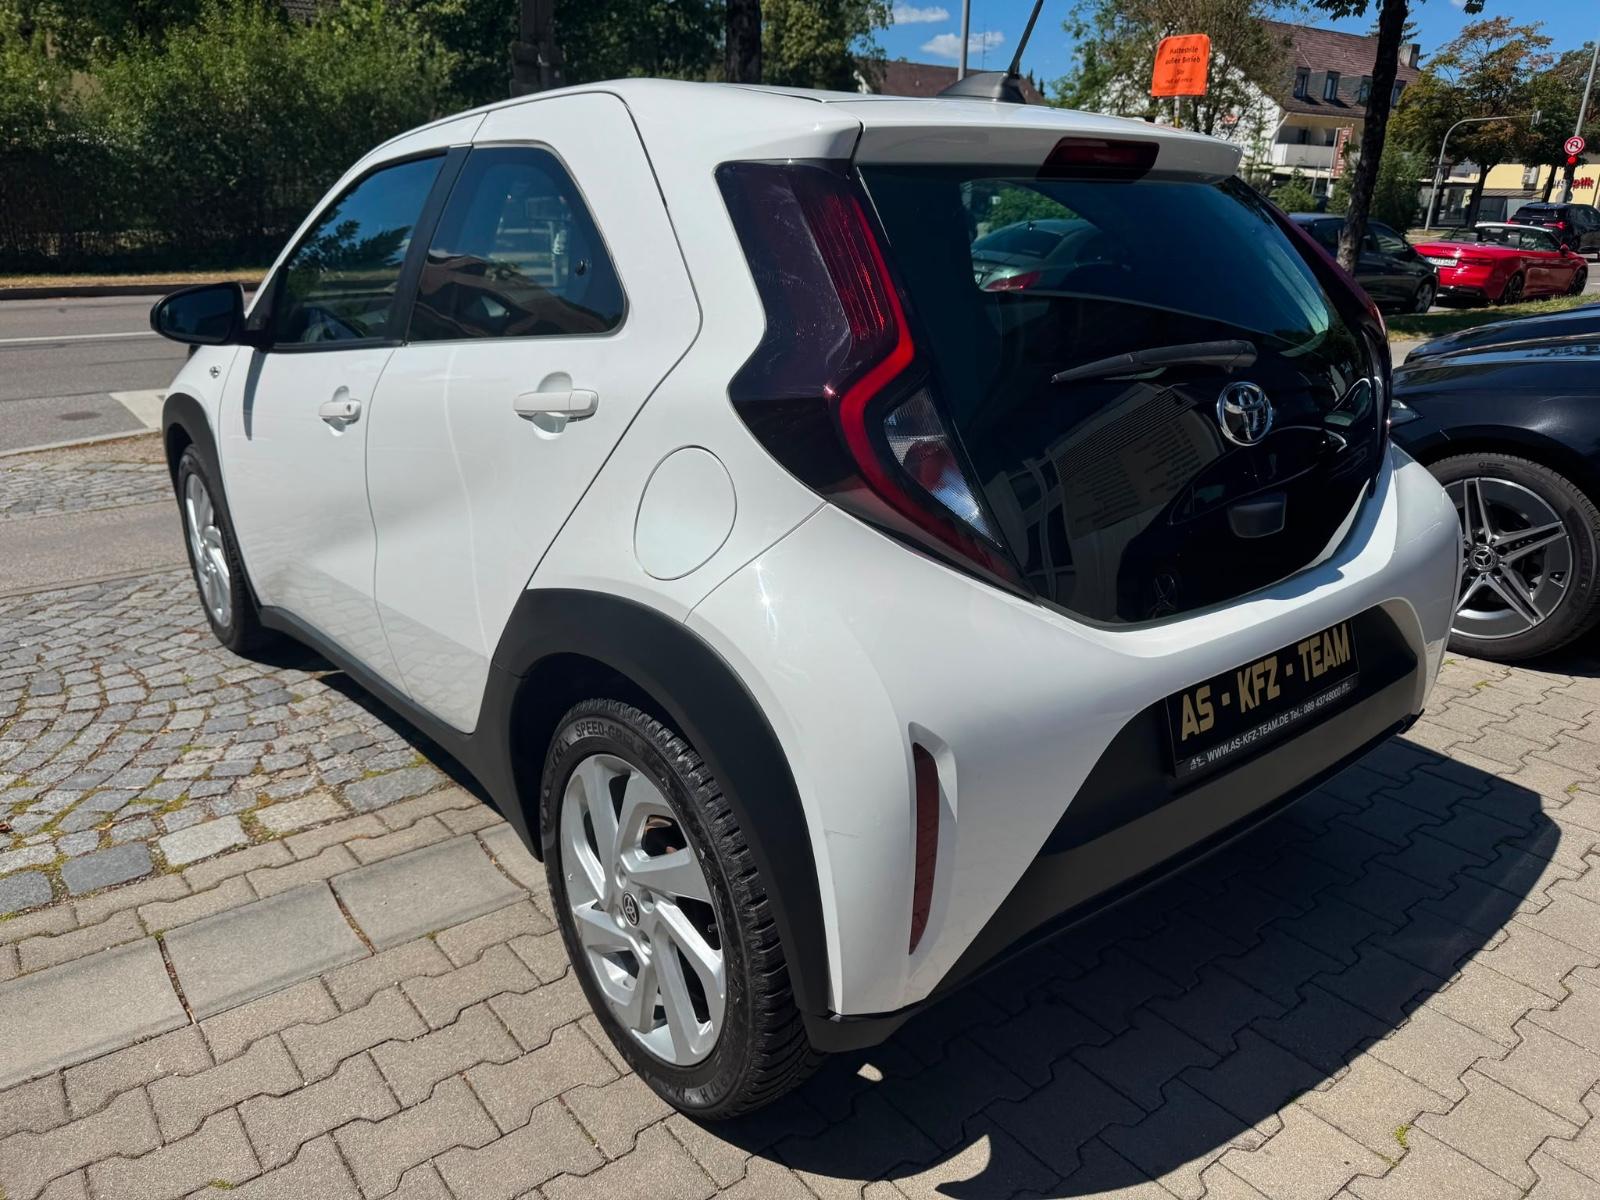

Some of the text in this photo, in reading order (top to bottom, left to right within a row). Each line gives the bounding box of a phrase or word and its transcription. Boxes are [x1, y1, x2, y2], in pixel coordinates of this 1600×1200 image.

[1181, 622, 1351, 742] AS KFZ TEAM
[1206, 713, 1289, 763] WWW.AS-KFZ-TEAM.DE
